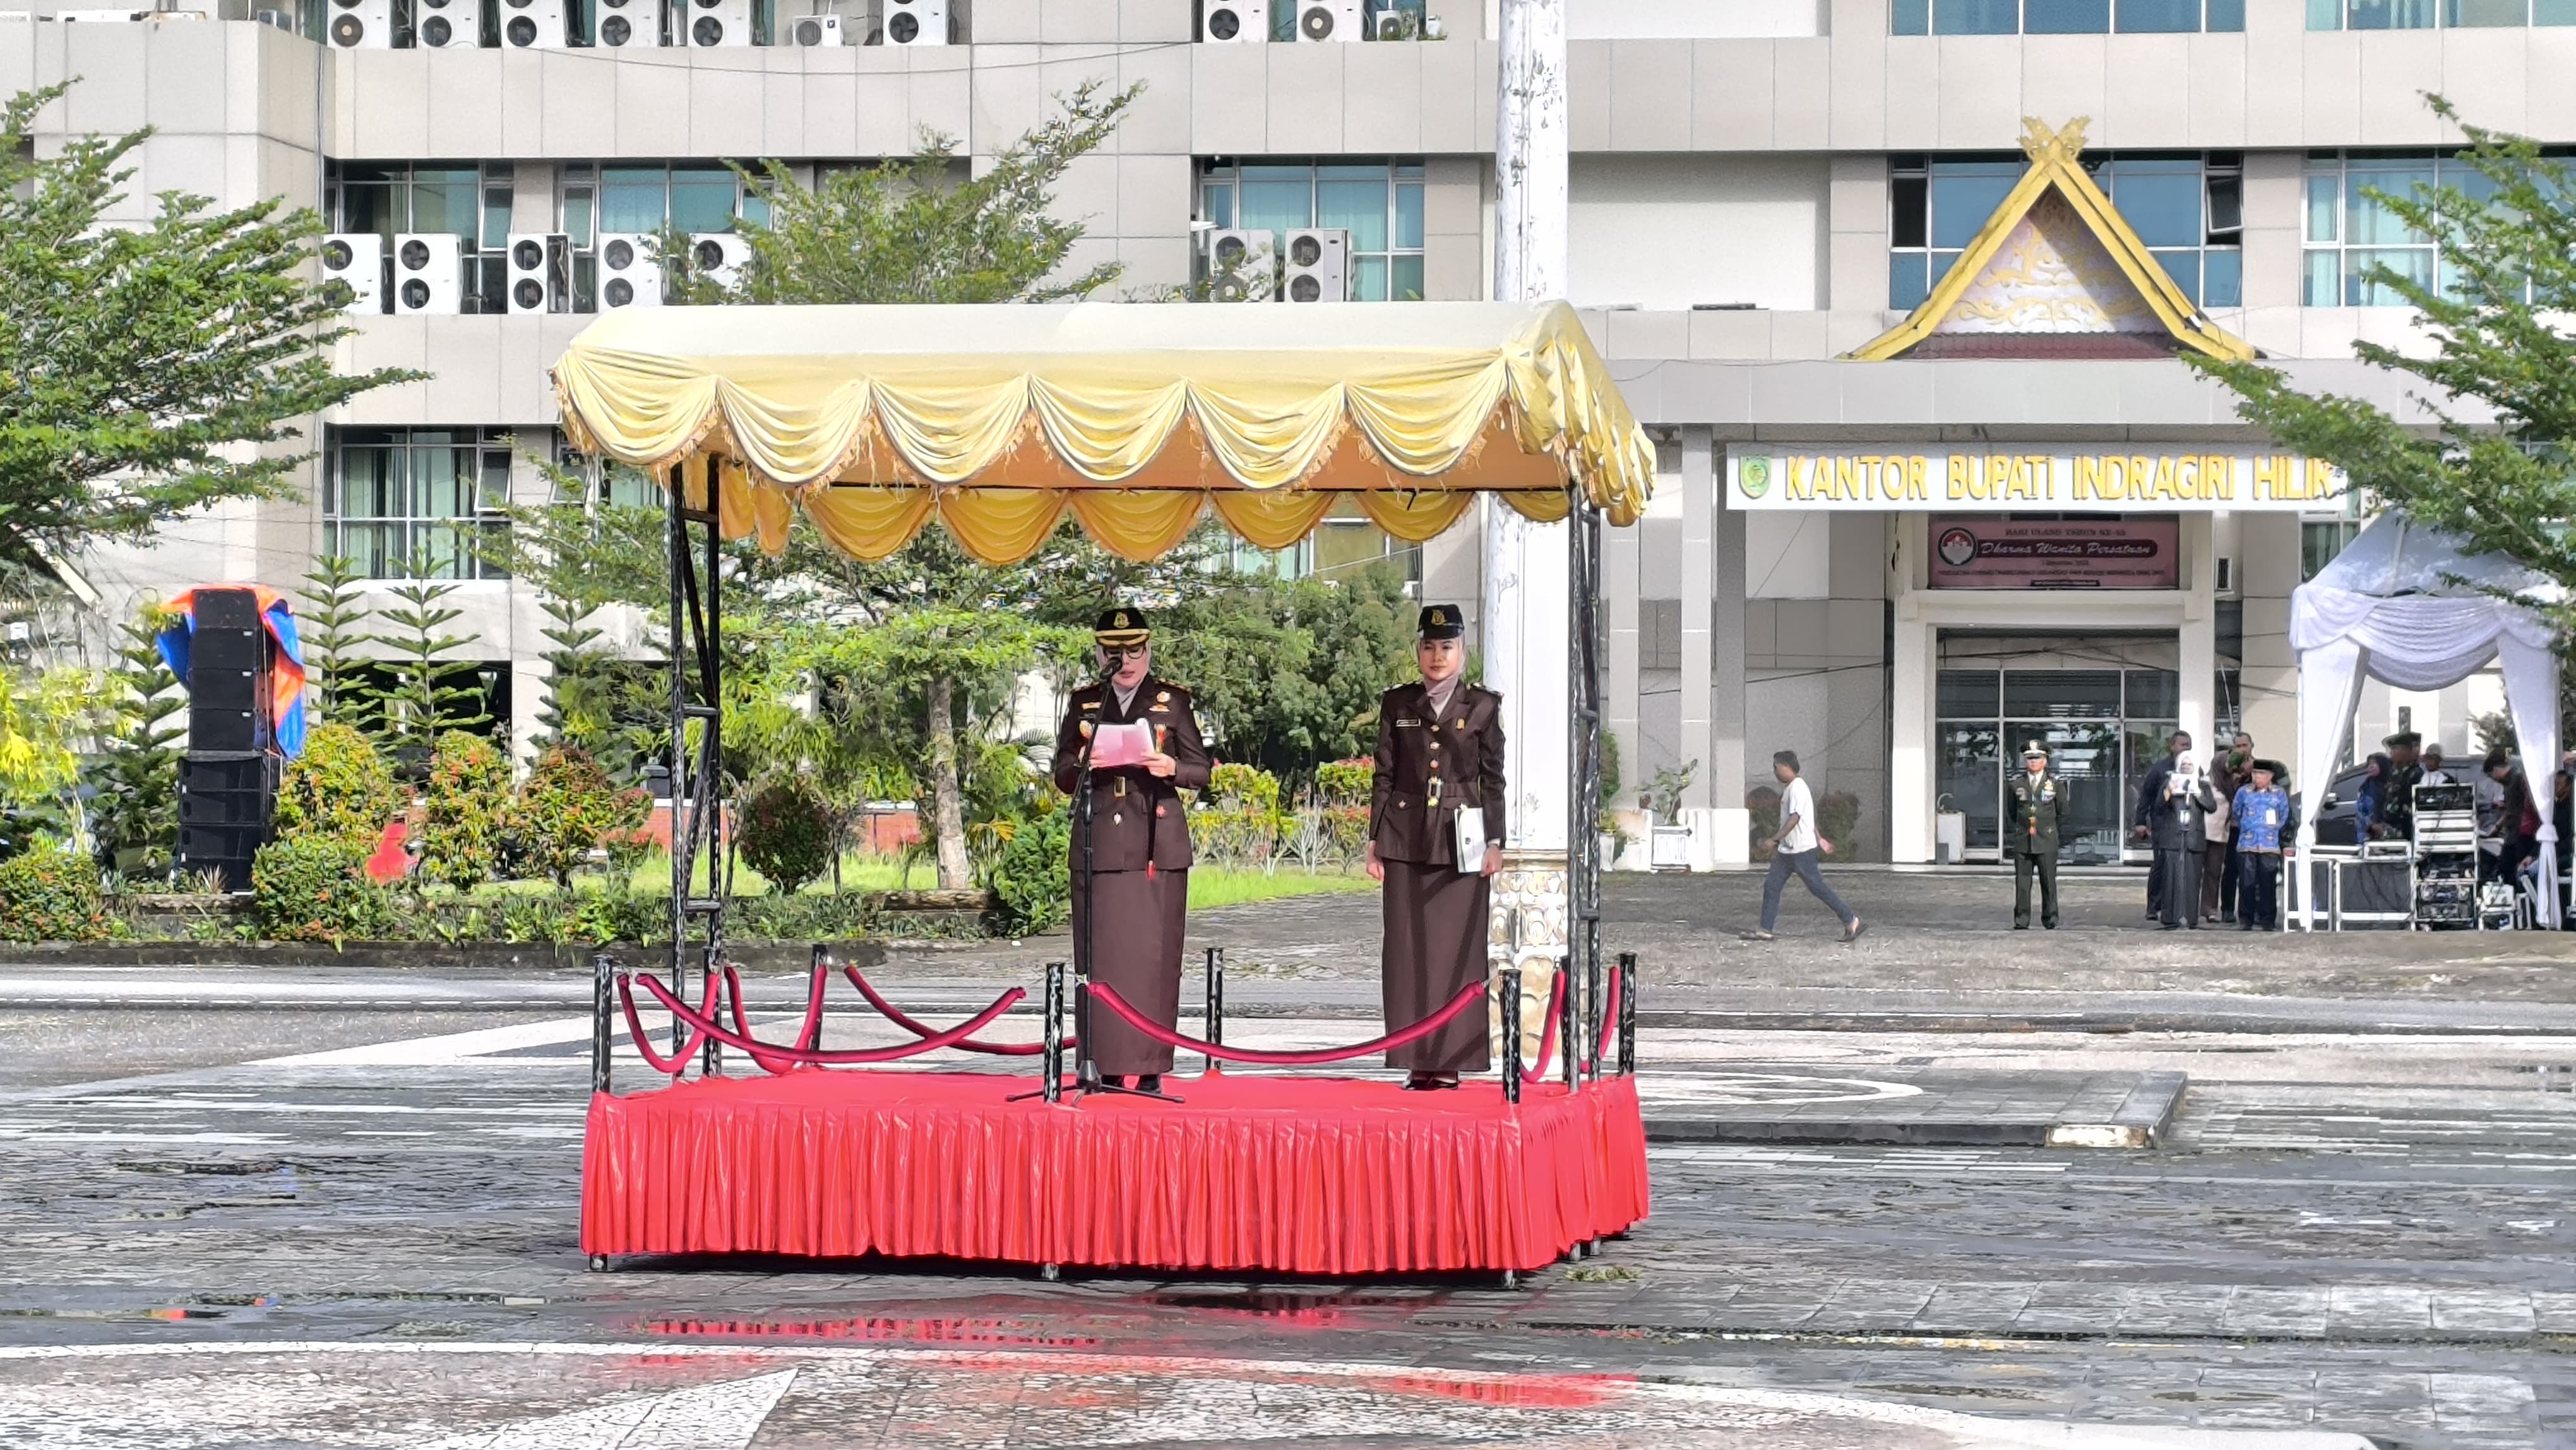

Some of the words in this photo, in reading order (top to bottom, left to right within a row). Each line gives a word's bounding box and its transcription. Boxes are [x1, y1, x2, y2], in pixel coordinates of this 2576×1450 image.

[1786, 455, 1928, 500] KANTOR
[1947, 454, 2055, 500] BUPATI
[2073, 454, 2236, 500] INDRAGIRI
[2253, 455, 2334, 500] HILIR
[1981, 542, 2032, 554] Dharma
[2035, 542, 2082, 554] Wanita
[2087, 542, 2150, 554] Persatuan
